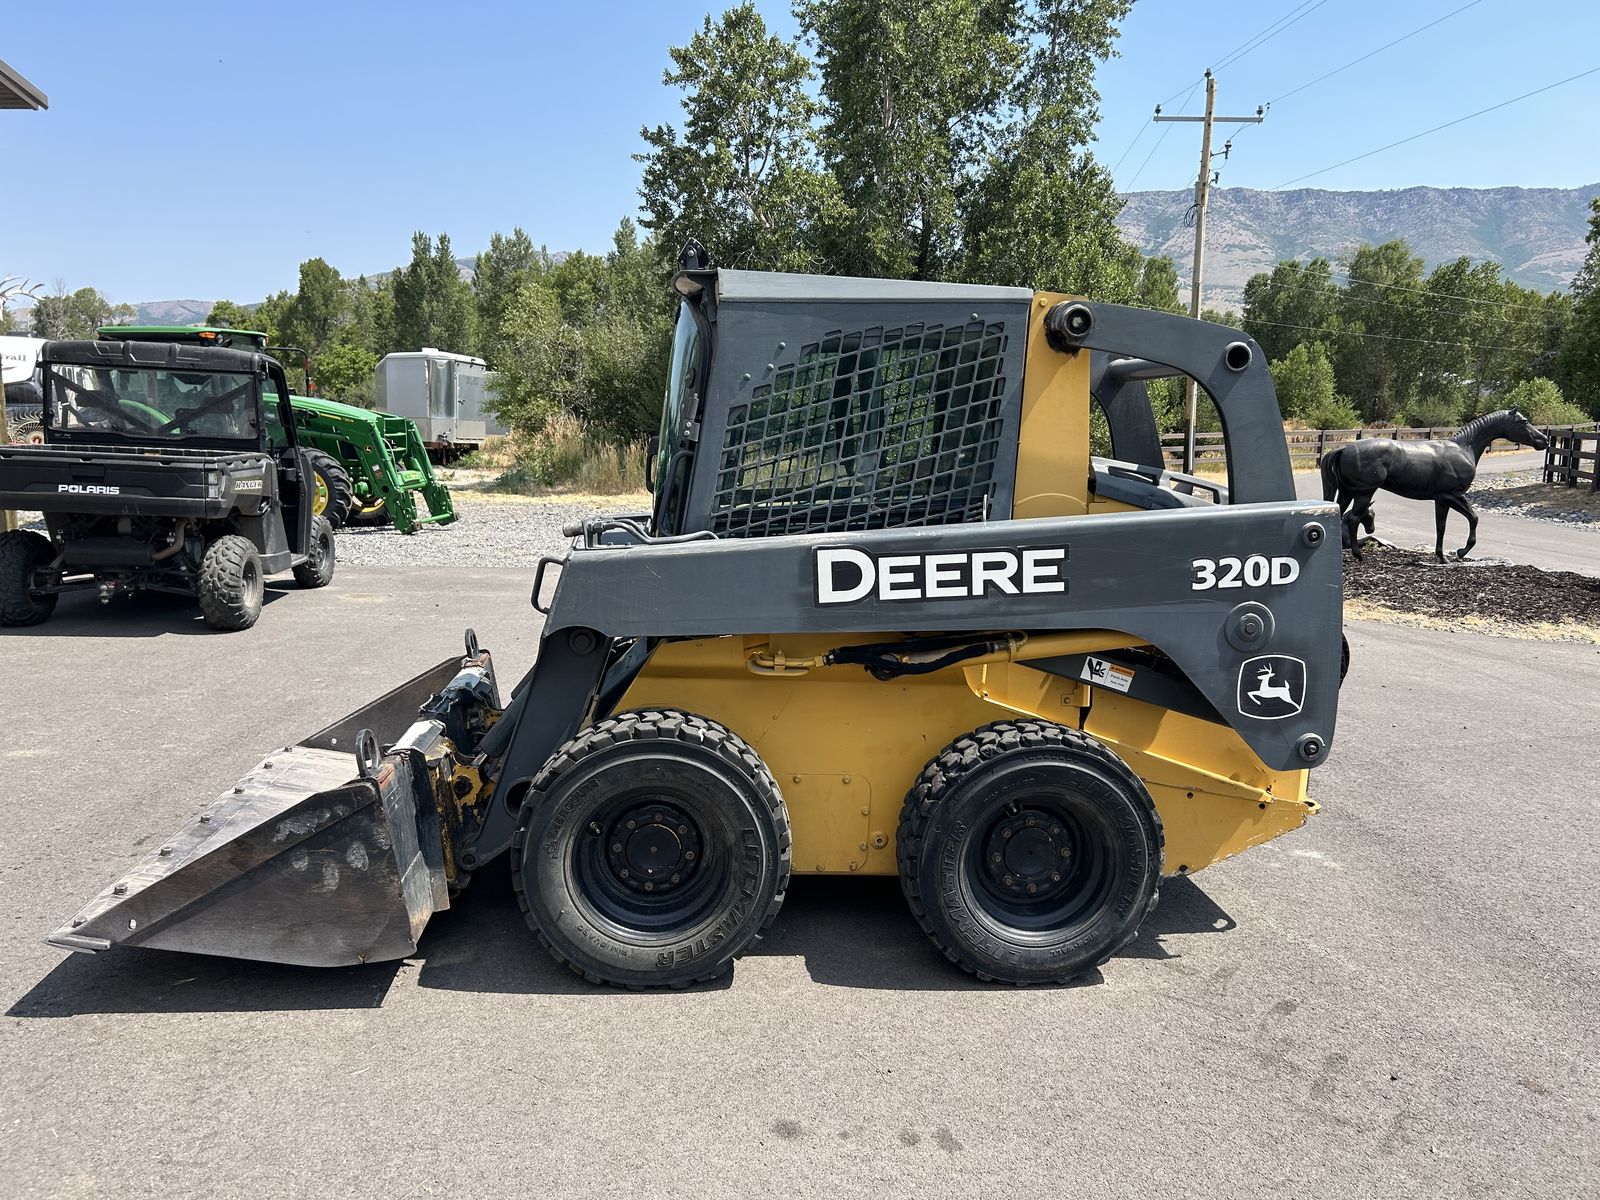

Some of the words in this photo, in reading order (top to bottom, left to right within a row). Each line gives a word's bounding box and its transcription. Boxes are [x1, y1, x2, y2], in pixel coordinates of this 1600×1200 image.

[58, 484, 120, 495] POLARIS
[235, 480, 264, 490] RANGER
[817, 548, 1066, 604] DEERE
[1192, 555, 1300, 591] 320D
[656, 827, 761, 969] LIFEMASTER
